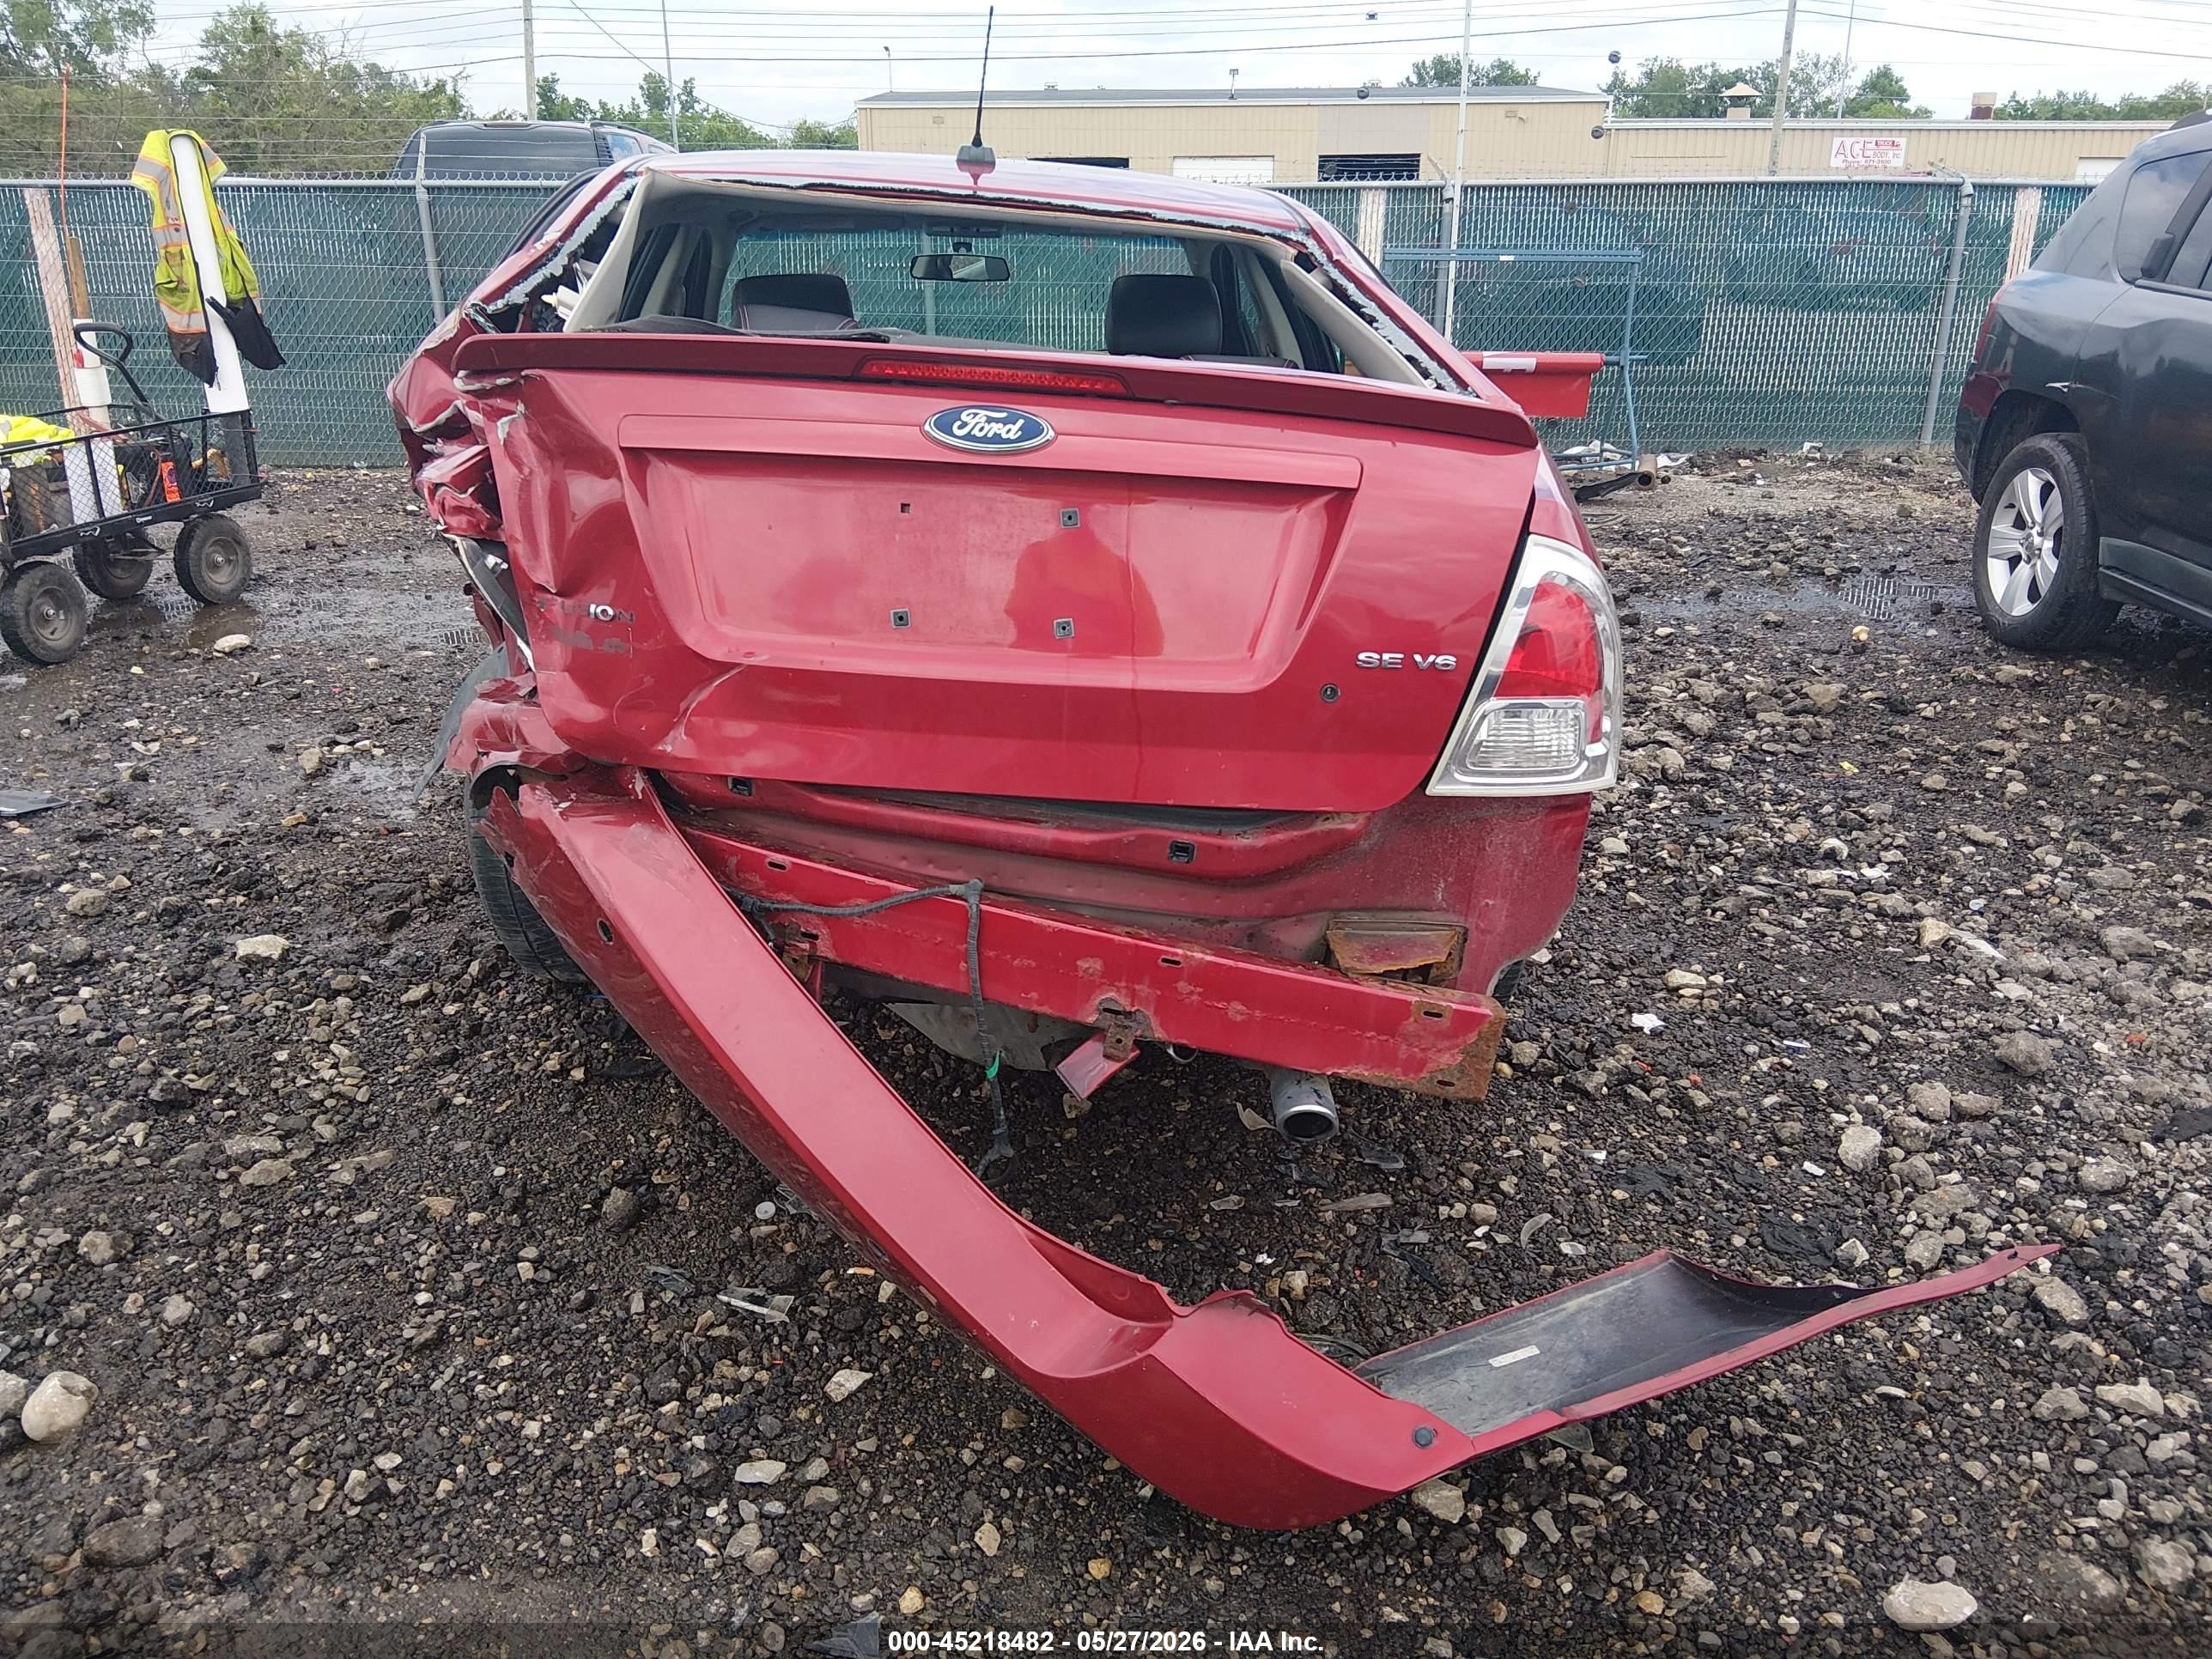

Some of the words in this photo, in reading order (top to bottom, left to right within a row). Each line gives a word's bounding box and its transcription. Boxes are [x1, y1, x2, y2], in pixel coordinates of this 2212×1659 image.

[1833, 140, 1873, 159] ACE
[952, 409, 1025, 440] Ford
[1356, 652, 1405, 668] SE
[1413, 653, 1457, 671] V6
